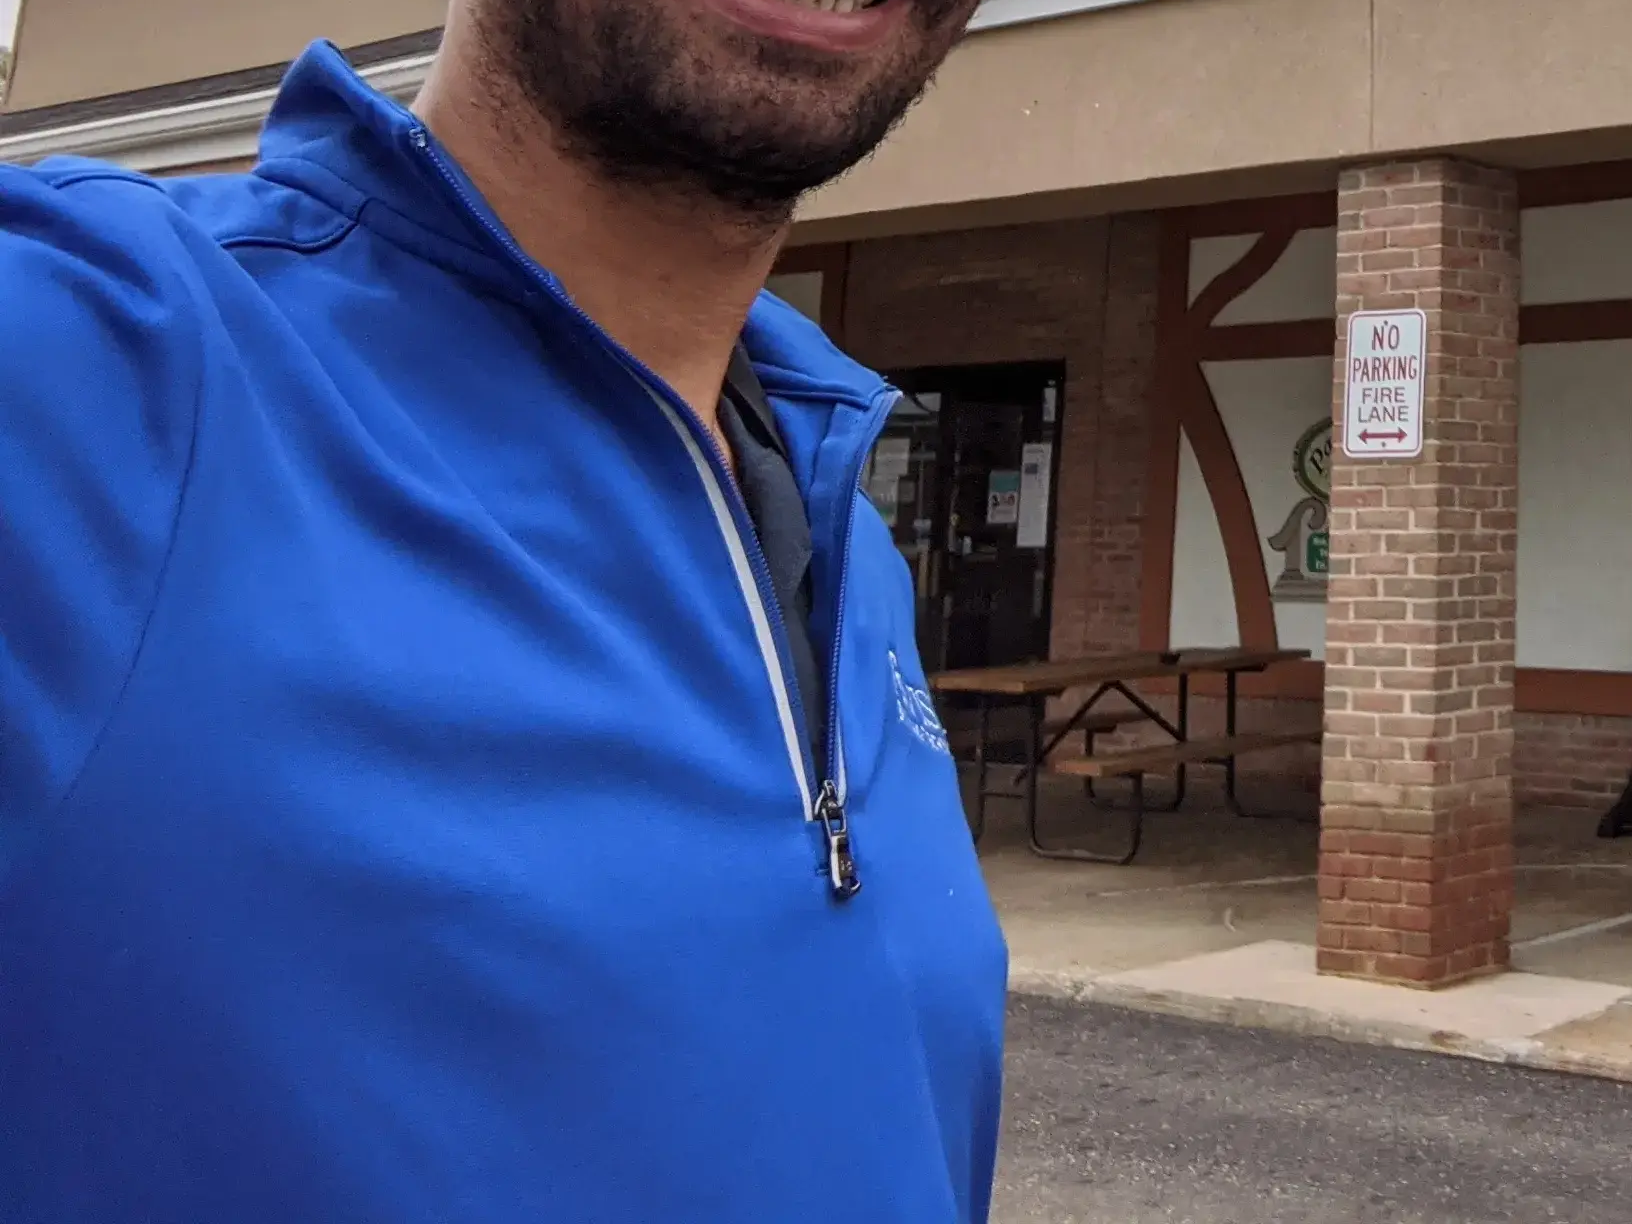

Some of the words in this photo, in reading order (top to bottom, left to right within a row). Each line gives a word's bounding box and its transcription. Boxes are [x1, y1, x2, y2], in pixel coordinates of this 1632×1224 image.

[1371, 325, 1401, 350] NO
[1351, 356, 1418, 383] PARKING
[1362, 386, 1406, 405] FIRE
[1357, 405, 1409, 423] LANE
